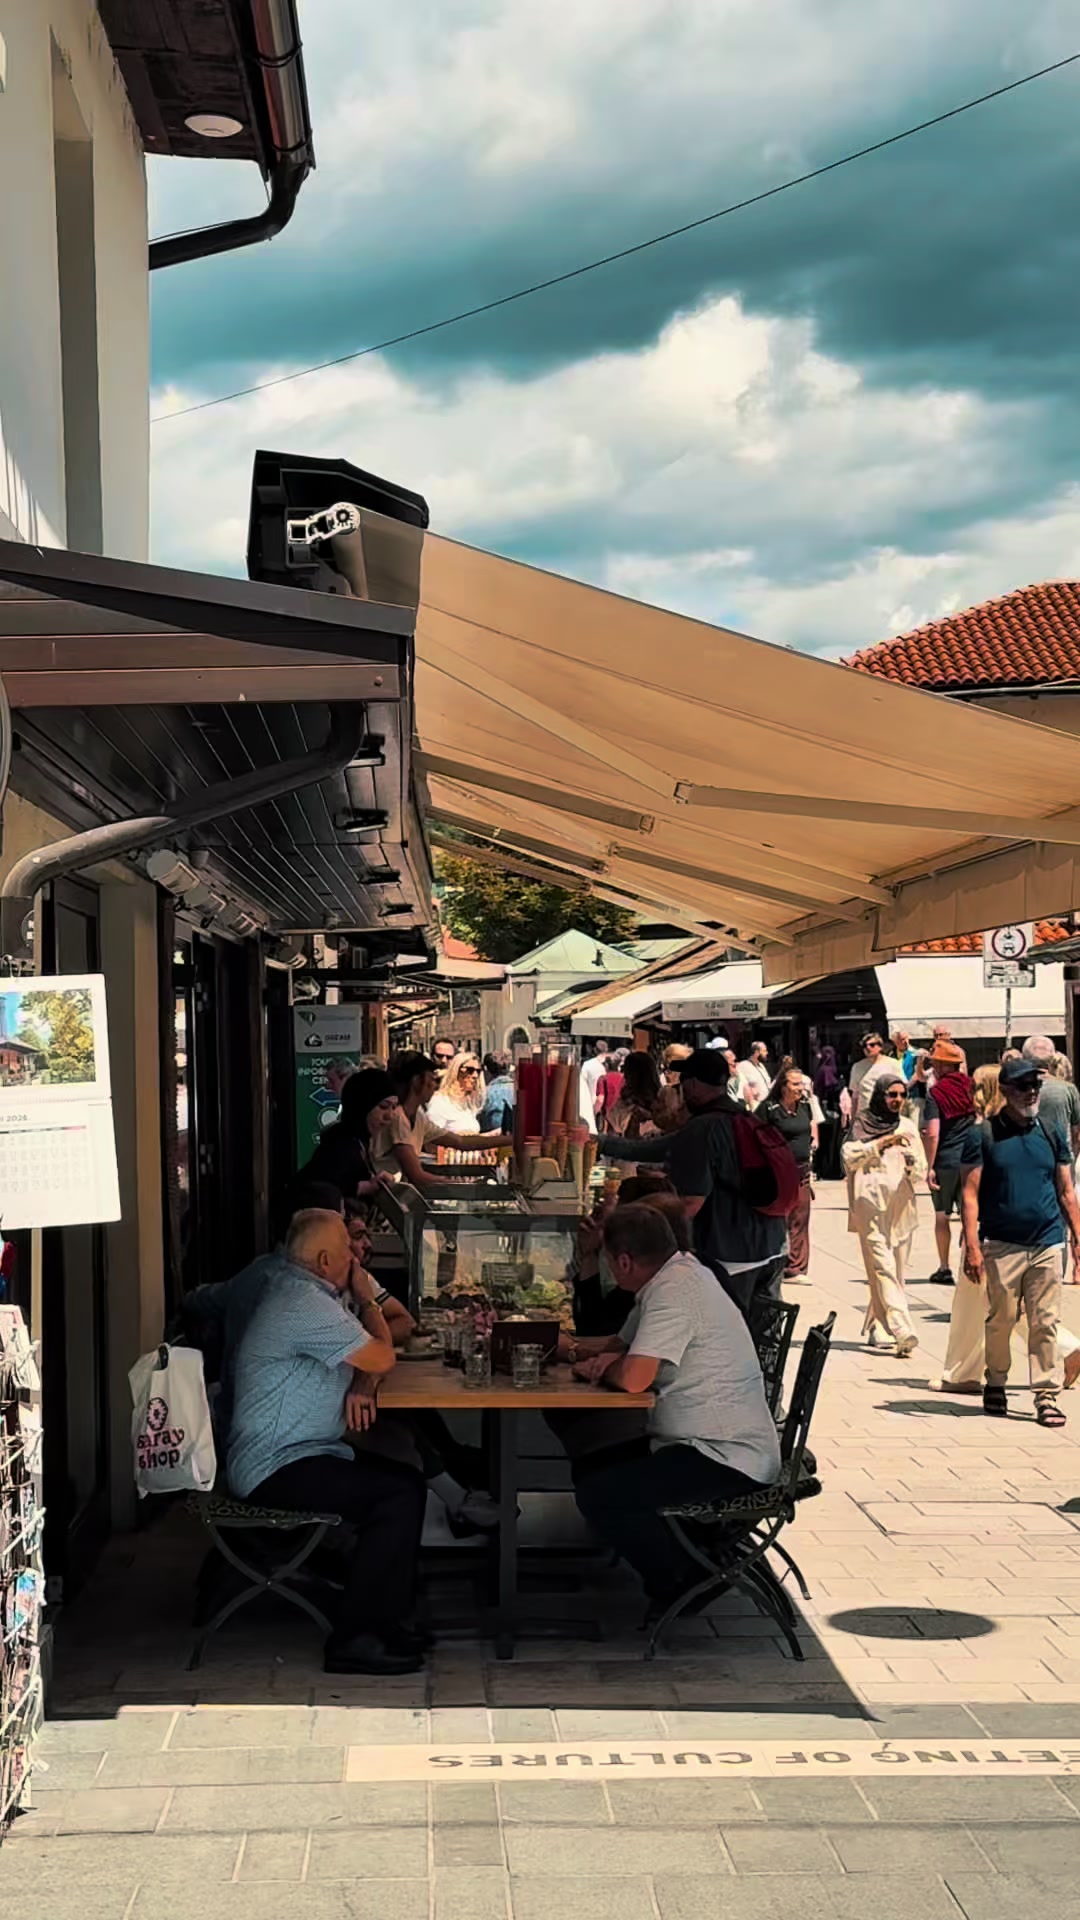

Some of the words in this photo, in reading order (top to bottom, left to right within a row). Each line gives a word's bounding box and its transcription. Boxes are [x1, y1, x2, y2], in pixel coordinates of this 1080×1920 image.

[137, 1428, 185, 1449] saray
[139, 1449, 180, 1469] shop
[428, 1752, 753, 1767] CULTURES
[775, 1750, 852, 1764] OF
